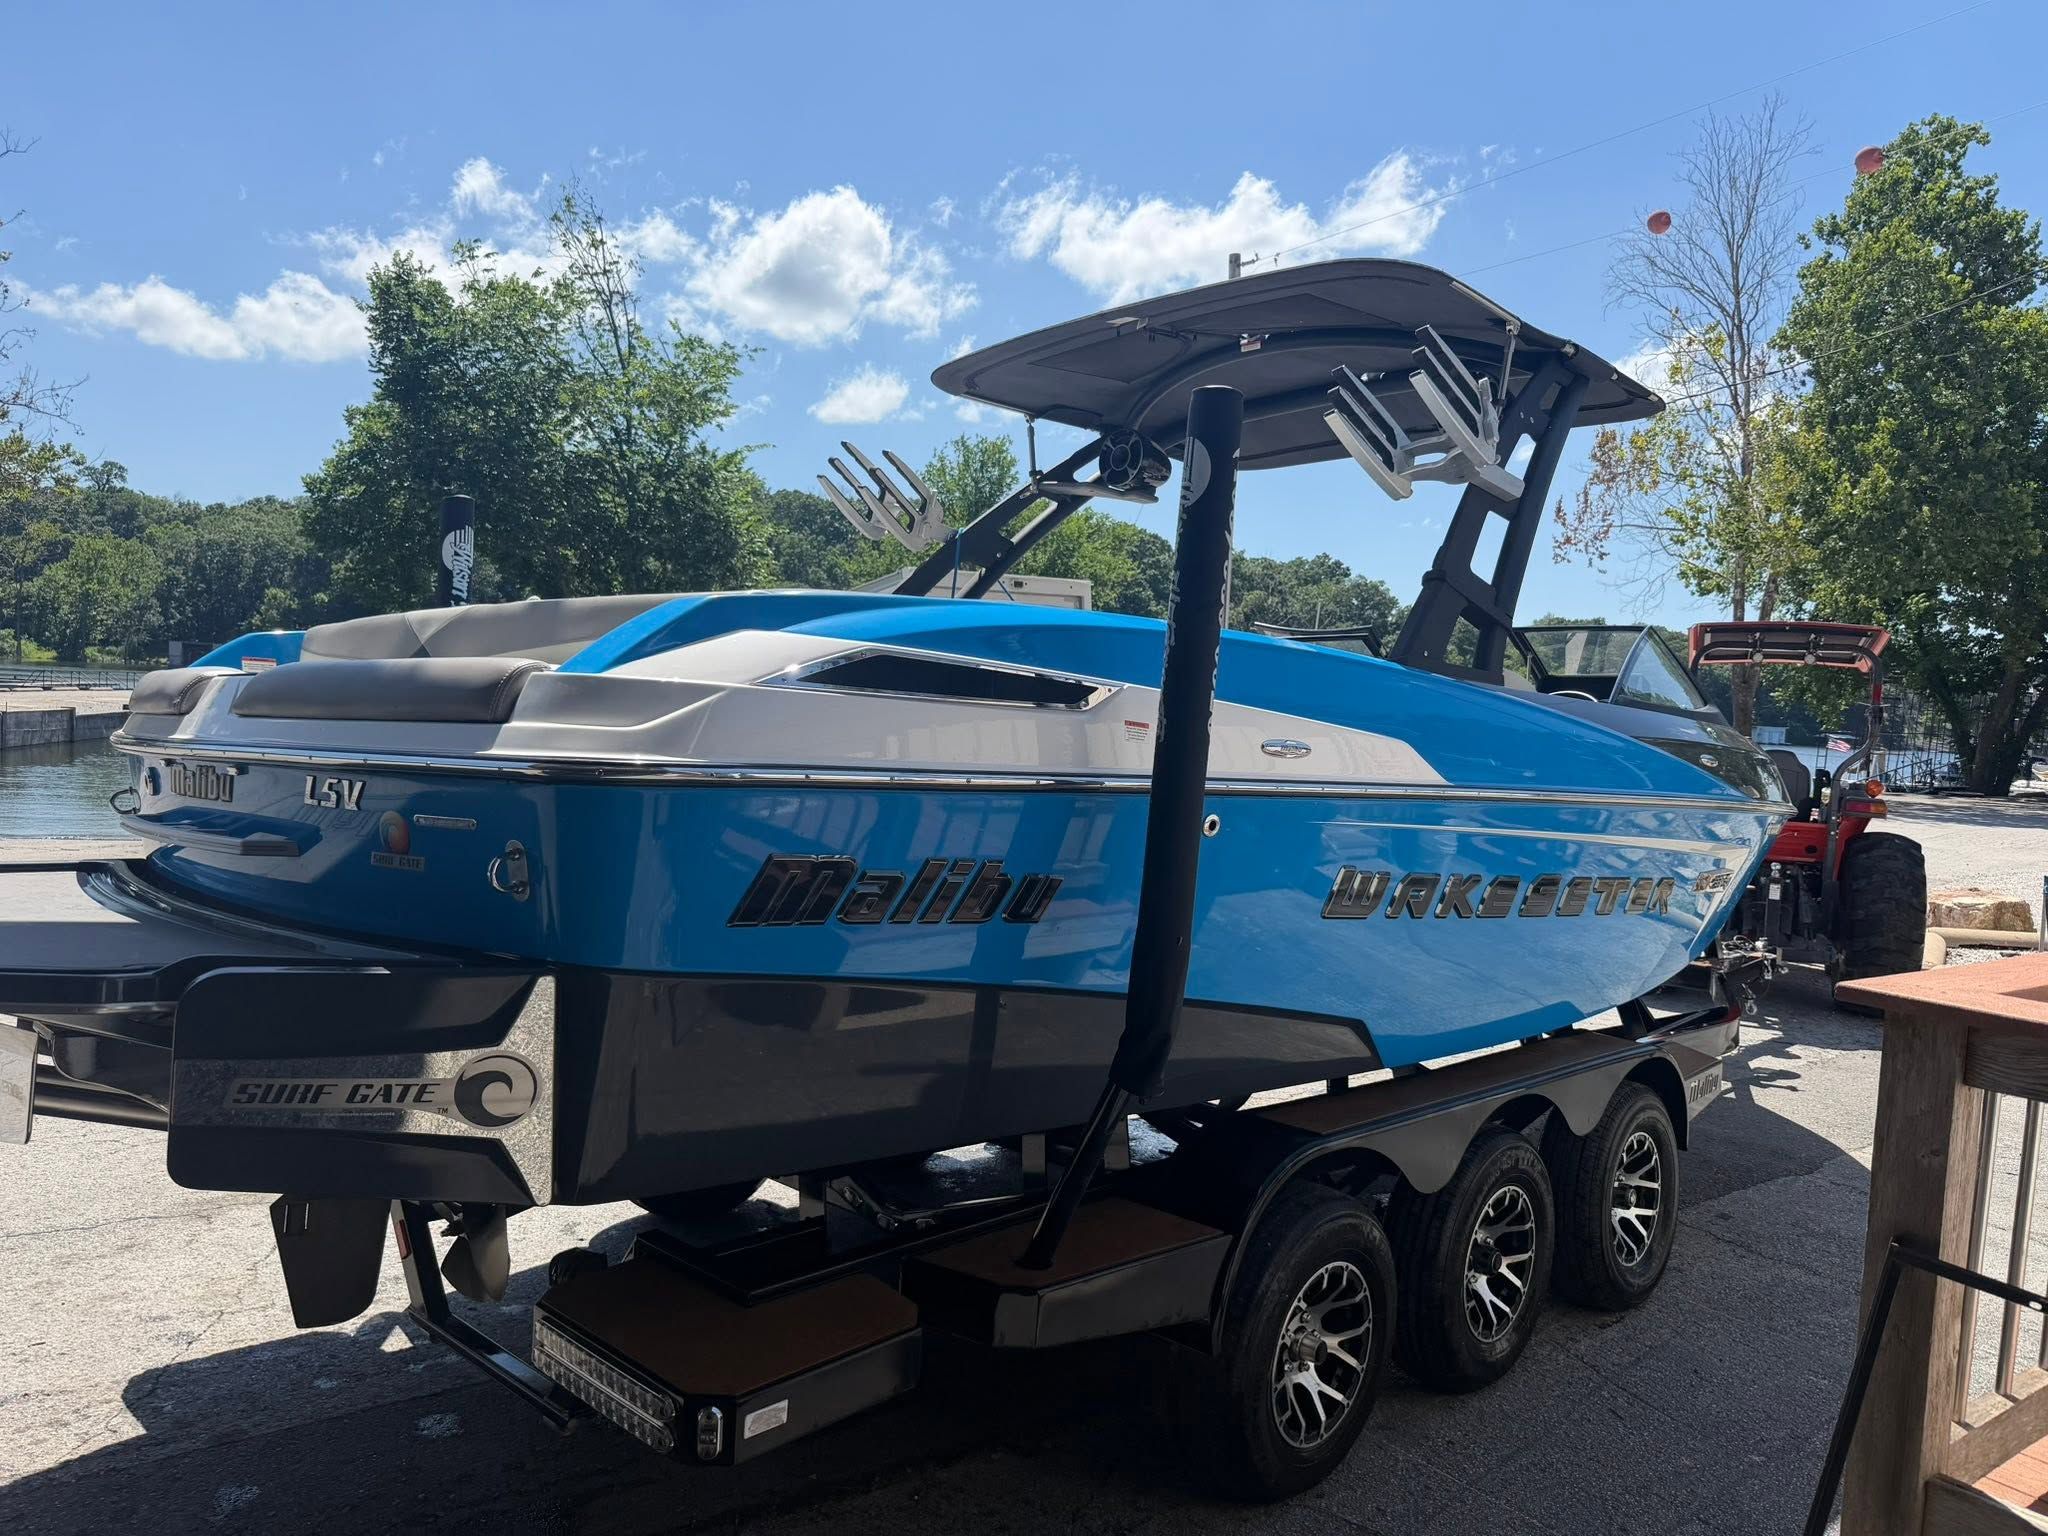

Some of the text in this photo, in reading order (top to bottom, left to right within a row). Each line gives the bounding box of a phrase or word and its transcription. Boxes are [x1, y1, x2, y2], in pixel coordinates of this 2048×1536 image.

[169, 761, 235, 803] Malibu
[304, 774, 366, 811] LSV
[726, 853, 1064, 928] Malibu
[231, 1083, 339, 1104] SURF
[344, 1083, 441, 1103] GATE
